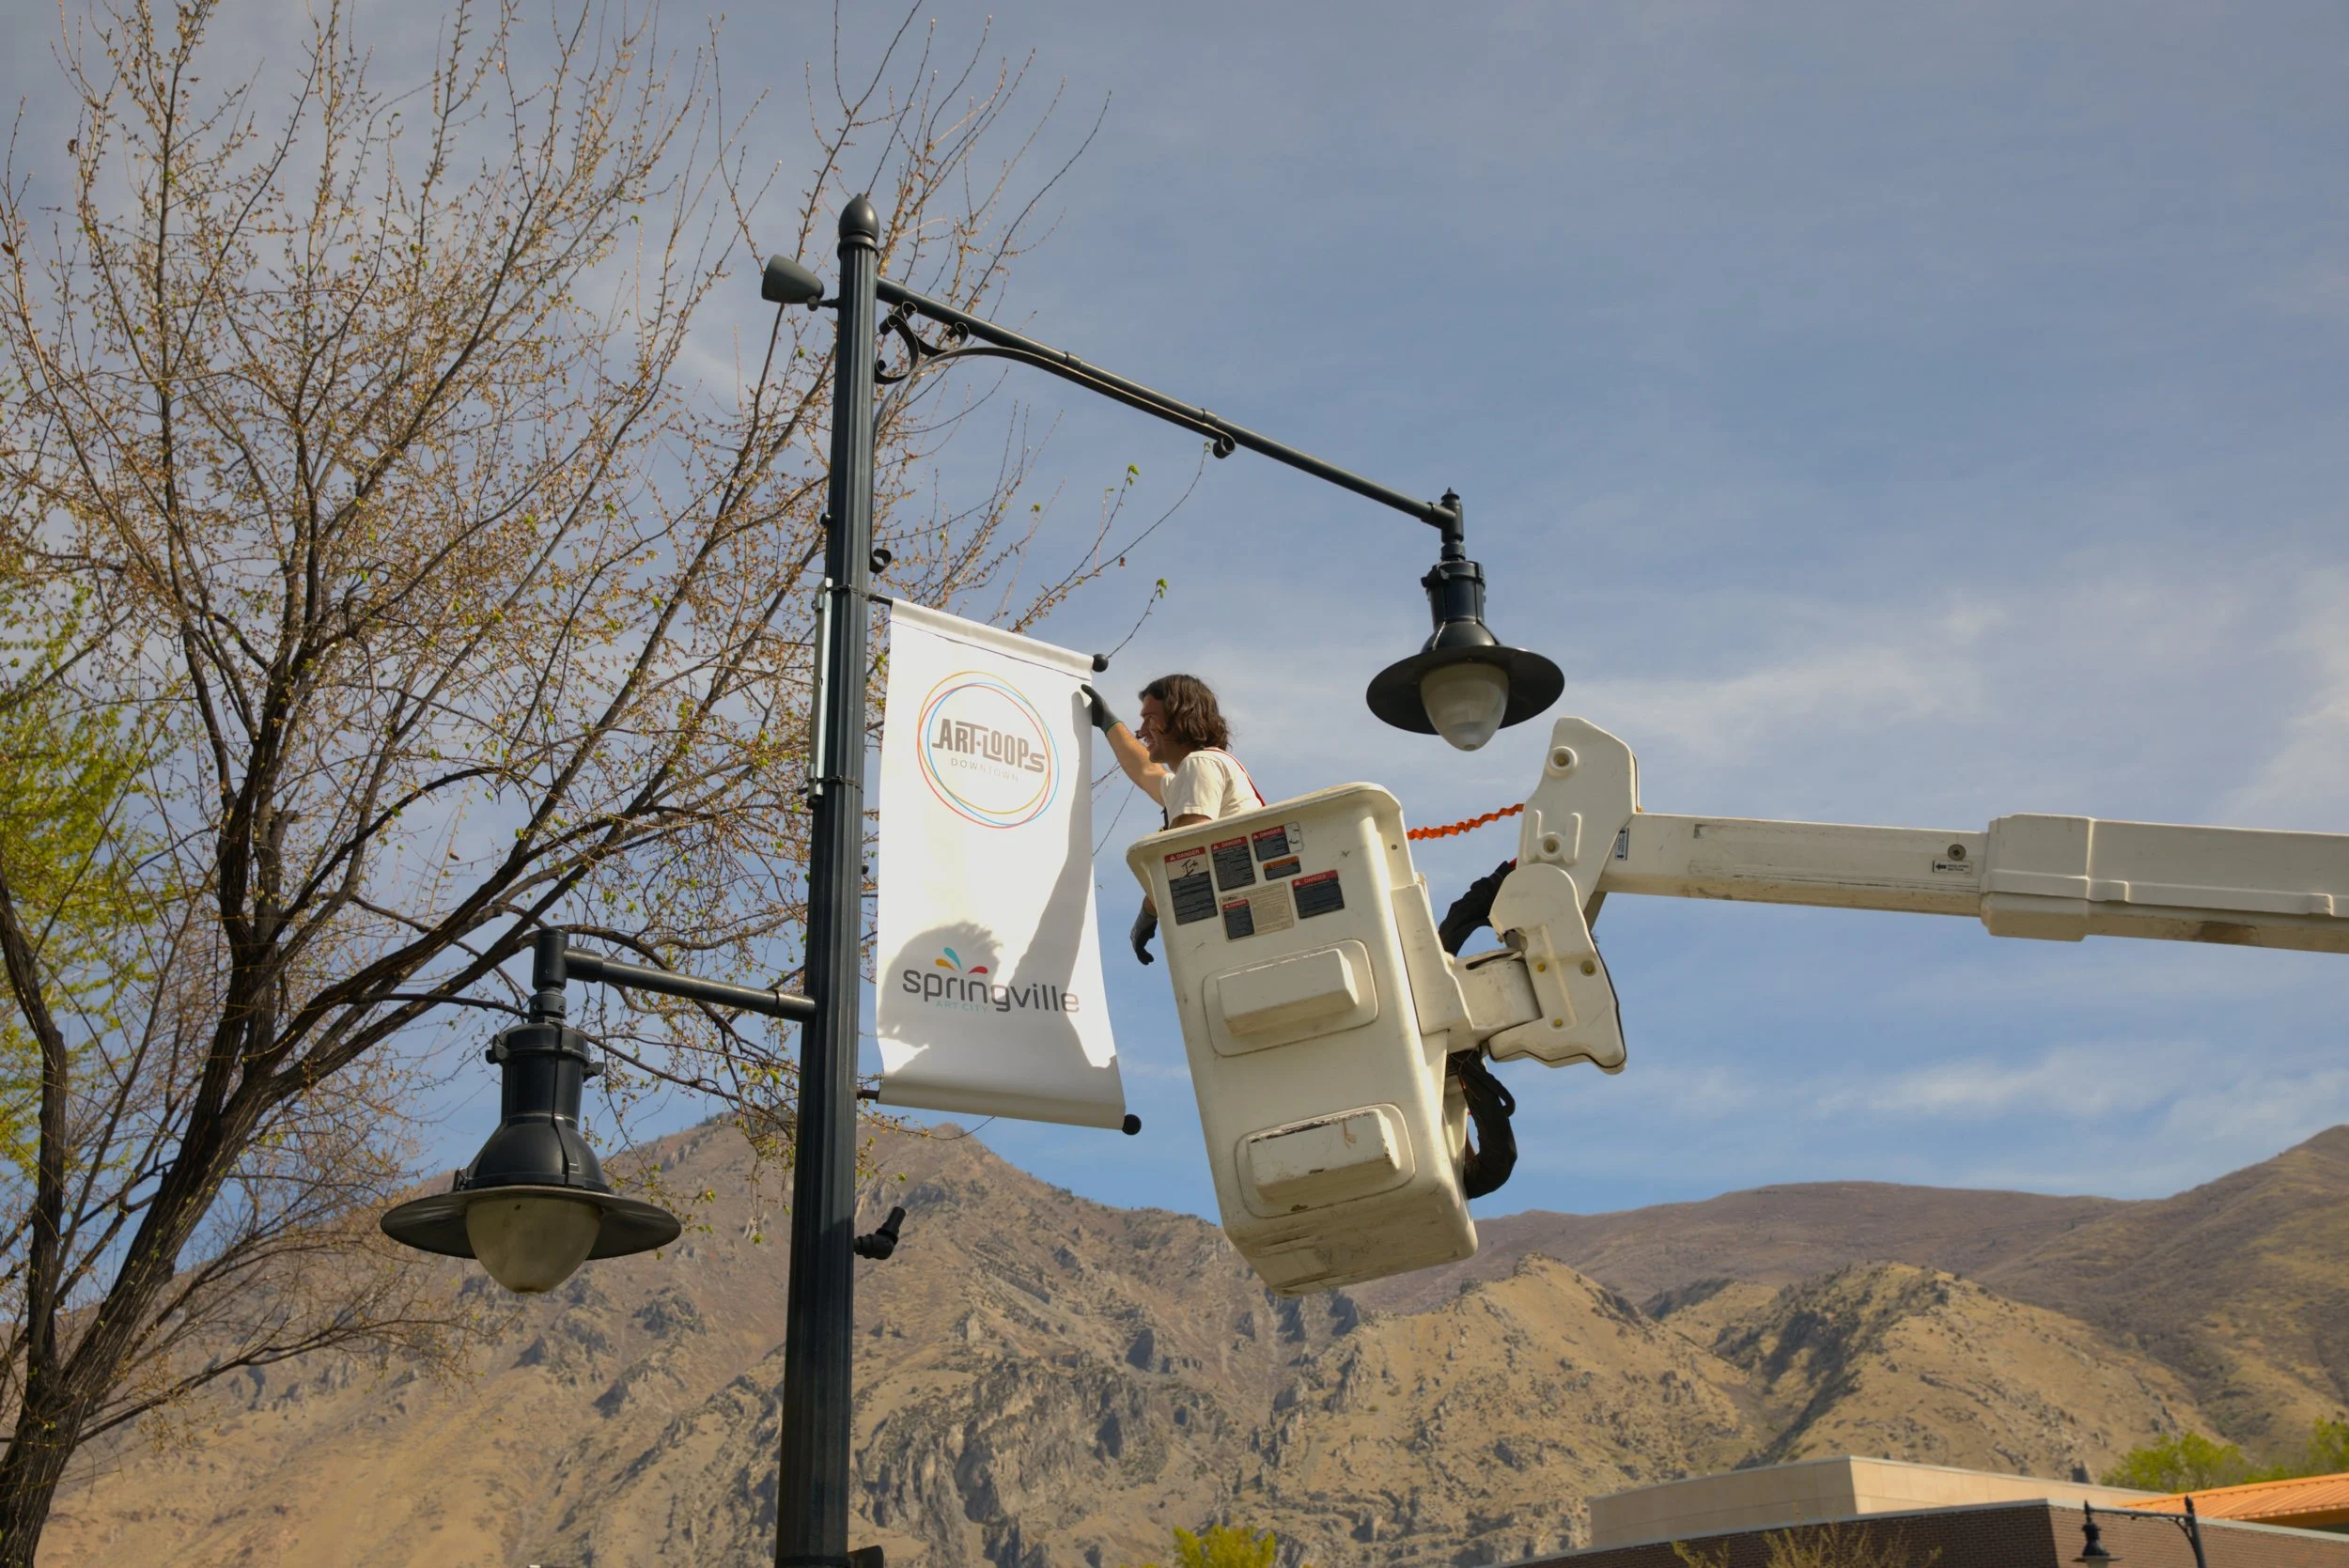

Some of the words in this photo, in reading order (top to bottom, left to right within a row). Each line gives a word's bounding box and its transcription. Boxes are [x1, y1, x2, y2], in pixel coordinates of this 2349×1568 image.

[950, 757, 1019, 782] DOWNTOWN
[1259, 828, 1282, 837] DANGER
[1221, 838, 1242, 847] DANGER
[1175, 848, 1201, 859] DANGER
[1303, 874, 1326, 883] DANGER
[902, 969, 1080, 1013] springville
[935, 1000, 958, 1010] ART
[961, 1002, 988, 1014] CITY
